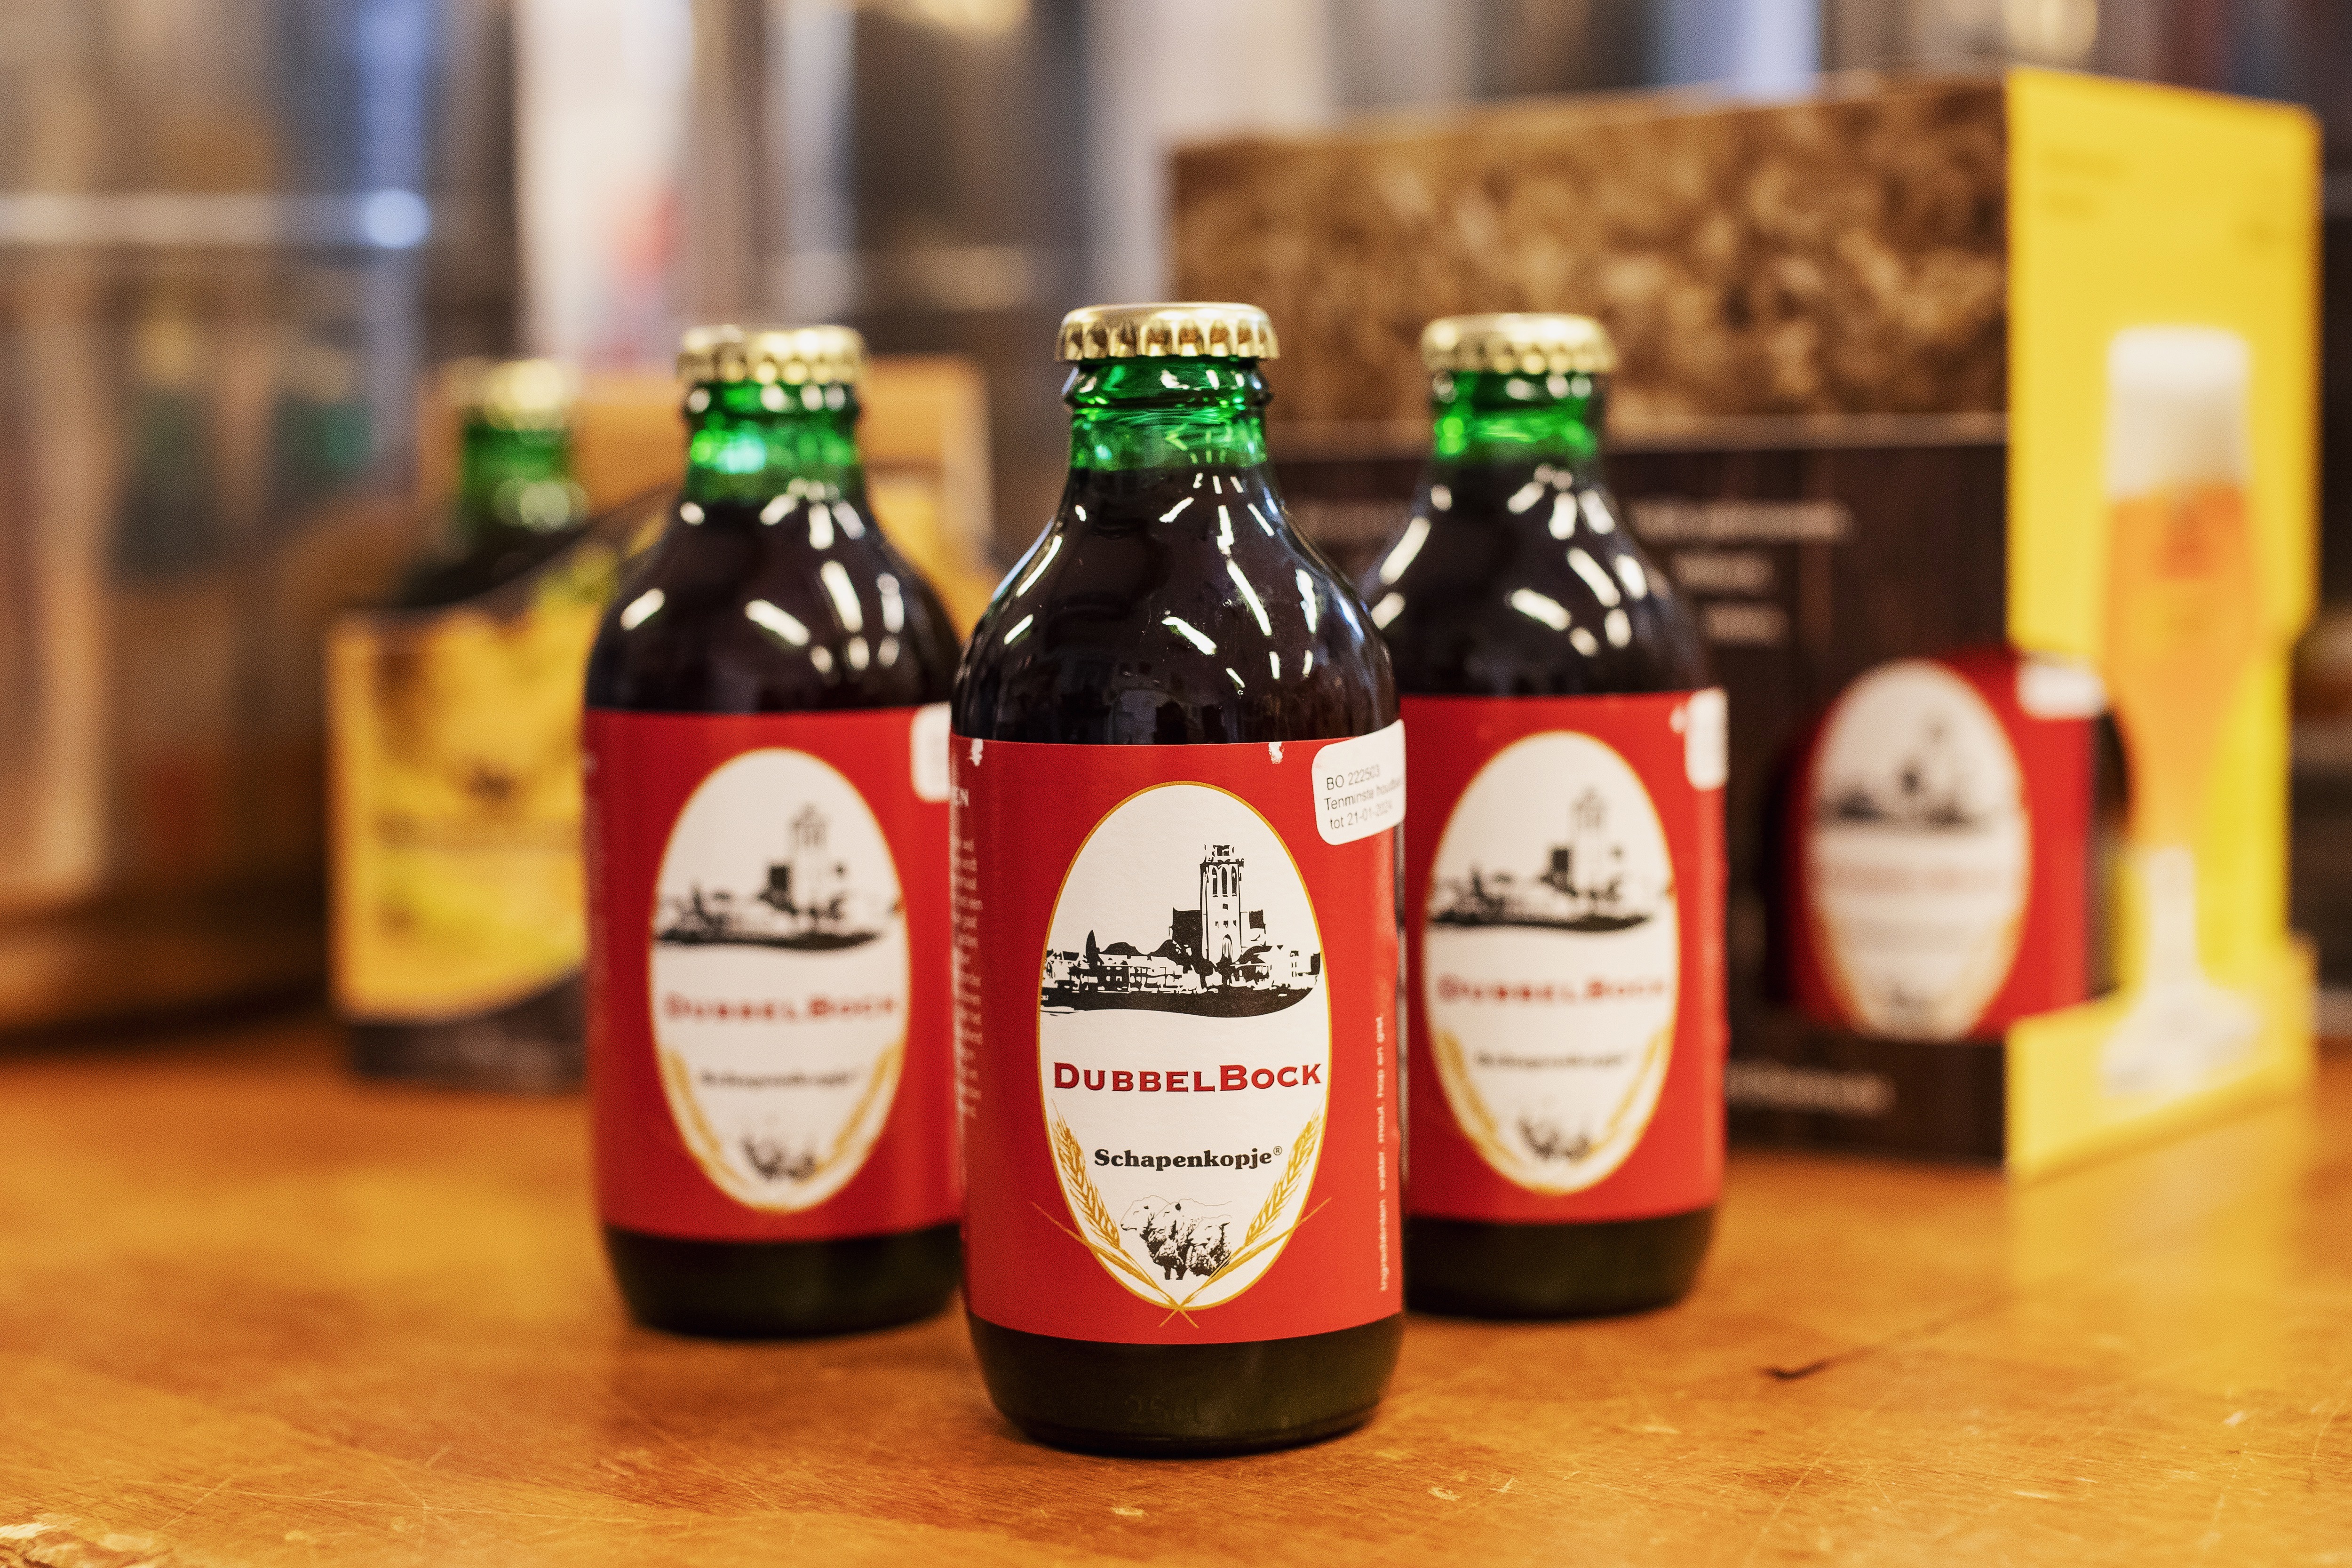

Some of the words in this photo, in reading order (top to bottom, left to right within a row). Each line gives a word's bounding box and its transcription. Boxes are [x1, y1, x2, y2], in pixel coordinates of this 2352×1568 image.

[1326, 775, 1344, 790] BO
[1324, 788, 1374, 810] Tenminste
[1330, 817, 1344, 829] tot
